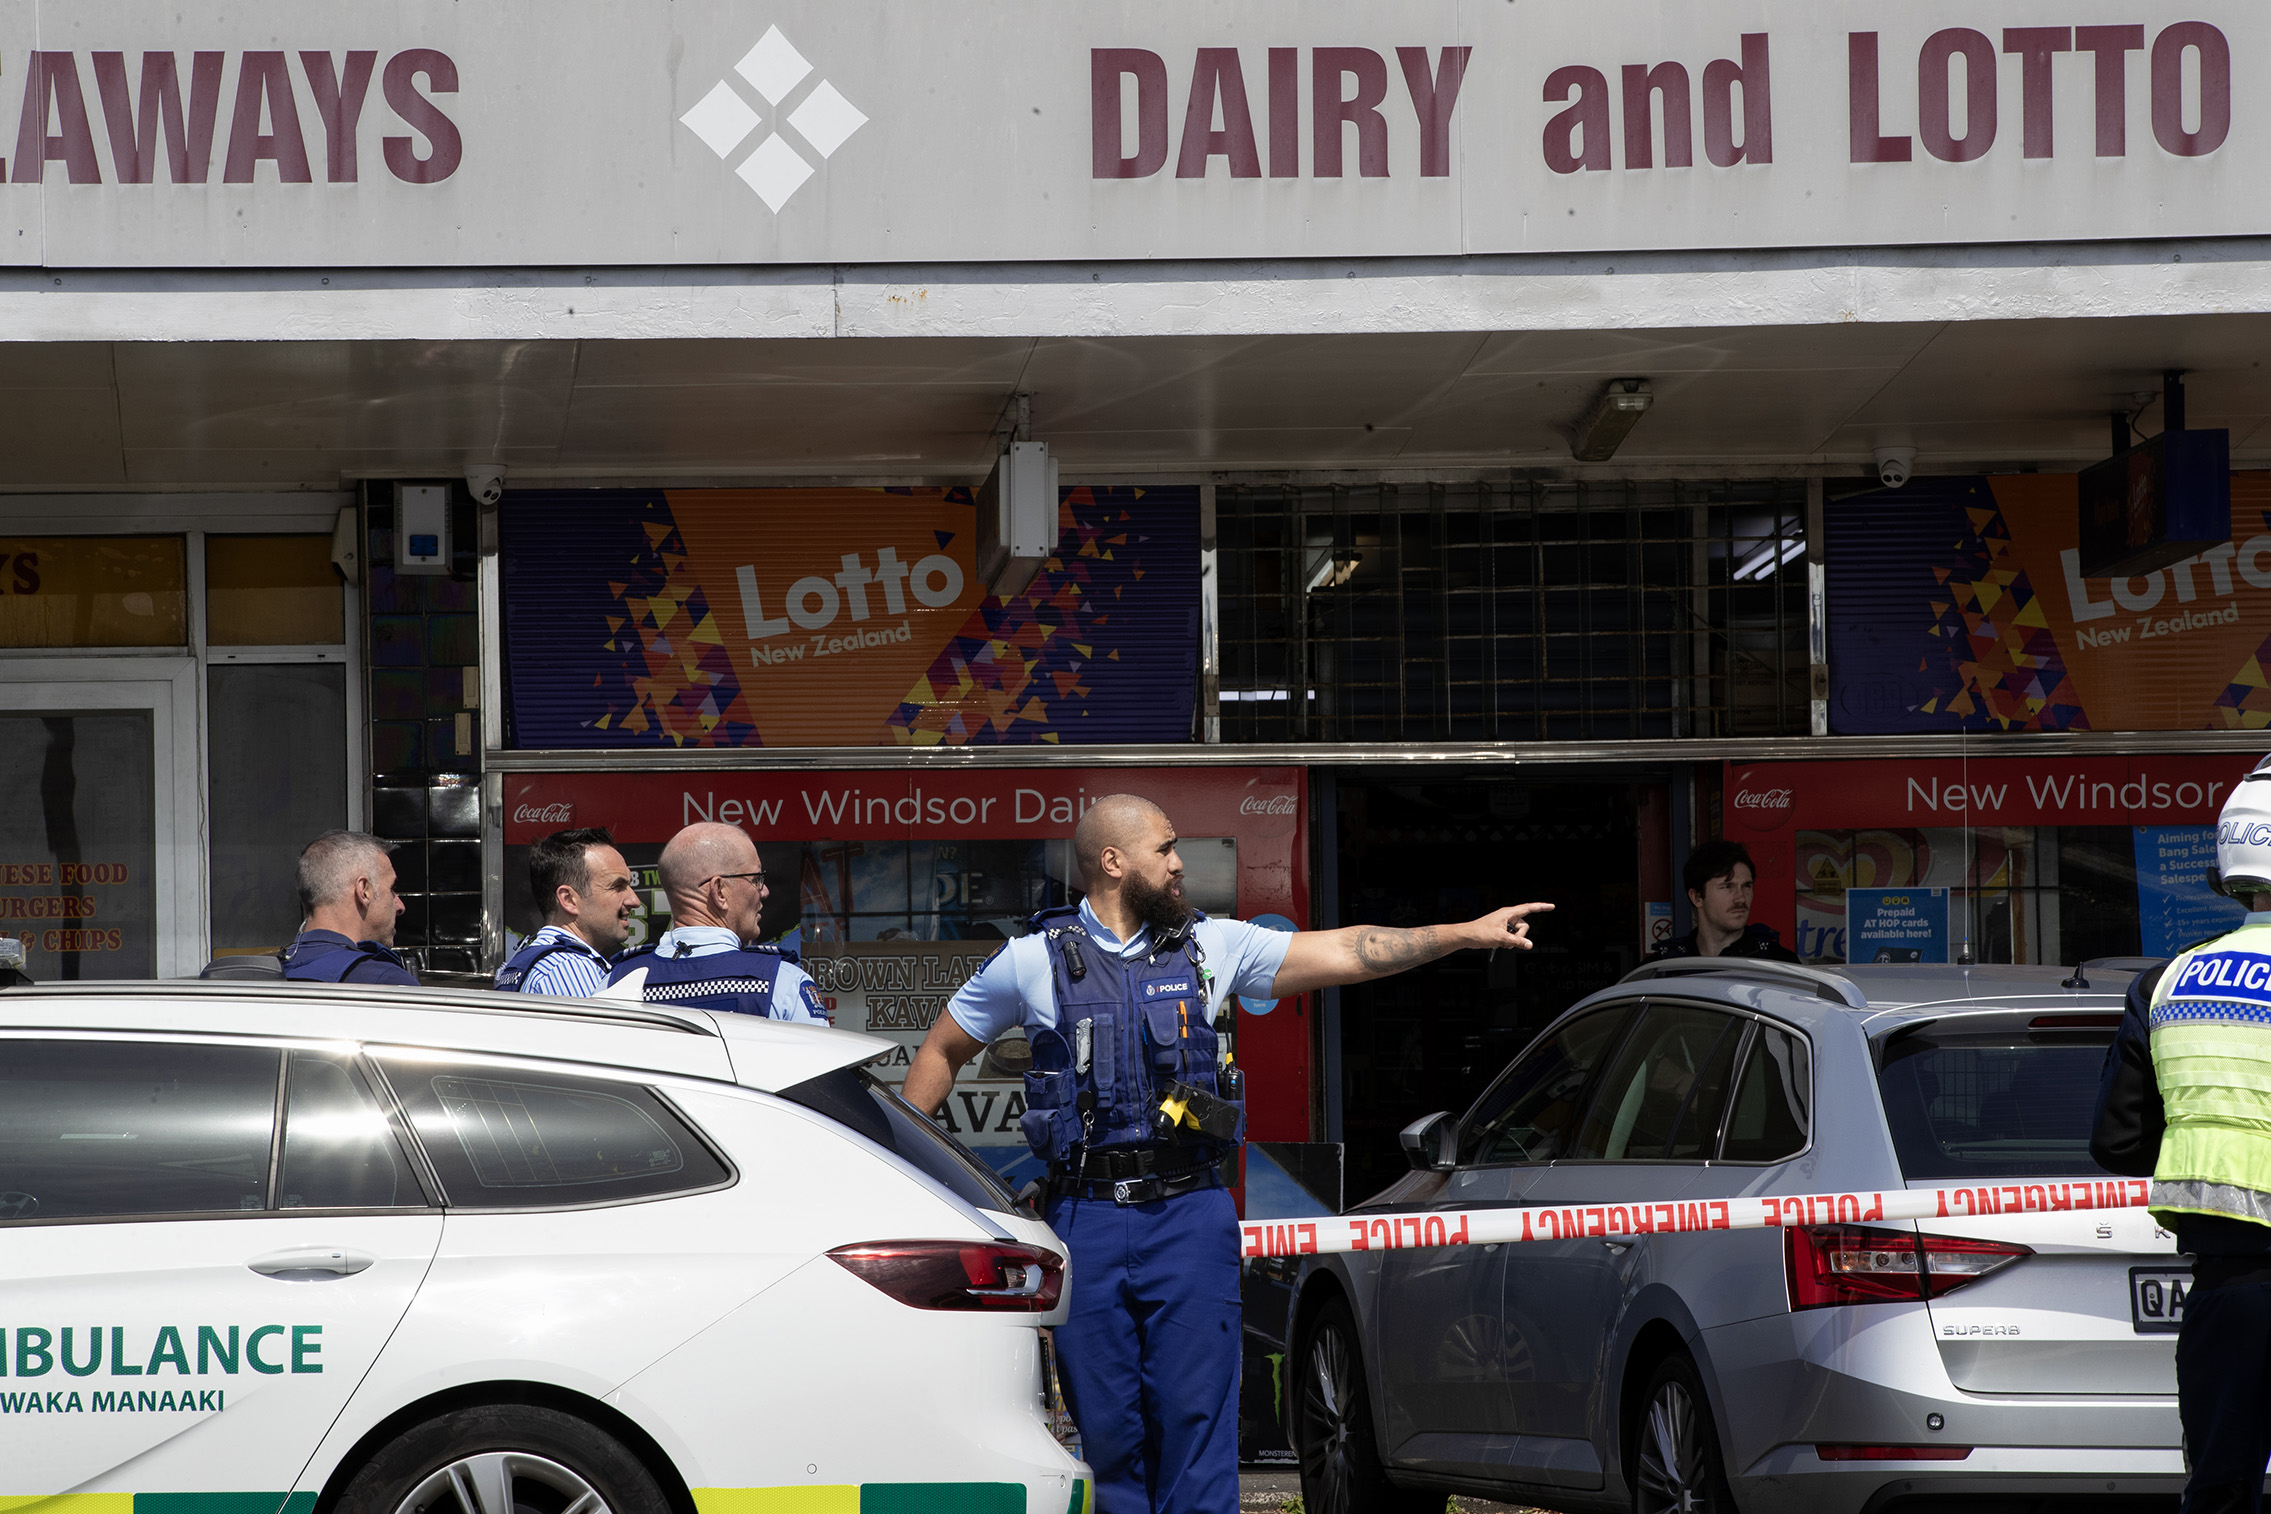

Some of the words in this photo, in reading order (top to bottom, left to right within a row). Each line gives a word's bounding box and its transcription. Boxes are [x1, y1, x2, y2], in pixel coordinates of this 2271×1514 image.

[1090, 46, 1473, 179] DAIRY
[1542, 32, 1773, 175] and
[1848, 20, 2231, 163] LOTTO
[0, 48, 463, 184] AWAYS
[0, 552, 40, 595] S
[736, 546, 965, 640] Lotto
[2075, 626, 2132, 650] New
[2136, 600, 2240, 639] Zealand
[750, 642, 806, 668] New
[813, 619, 912, 658] Zealand
[1240, 795, 1299, 815] Coca-Cola
[1734, 789, 1793, 808] Coca-Cola
[1907, 776, 2008, 812] New
[2026, 773, 2224, 810] Windsor
[513, 803, 574, 823] Coca-Cola
[683, 791, 783, 826] New
[801, 788, 996, 825] Windsor
[1015, 788, 1097, 825] Dai
[2157, 832, 2200, 844] Aiming
[2217, 821, 2271, 847] OLIC
[2159, 847, 2189, 859] Bang
[60, 862, 130, 886] FOOD
[2160, 873, 2207, 885] Salespe
[1864, 919, 1878, 928] AT
[1879, 918, 1900, 928] HOP
[1901, 917, 1929, 928] cards
[1876, 907, 1916, 918] Prepaid
[2211, 915, 2244, 924] experienc
[42, 927, 122, 952] CHIPS
[1860, 930, 1905, 939] available
[1906, 929, 1932, 939] here!
[2179, 958, 2271, 991] POLIC
[1159, 982, 1188, 993] POLICE
[1761, 1193, 1884, 1227] POLICE
[1240, 1222, 1318, 1258] EME
[1350, 1214, 1470, 1251] POLICE
[1943, 1325, 2021, 1336] SUPERB
[0, 1325, 323, 1377] BULANCE
[0, 1391, 84, 1413] WAKA
[91, 1390, 224, 1413] MANAAKI
